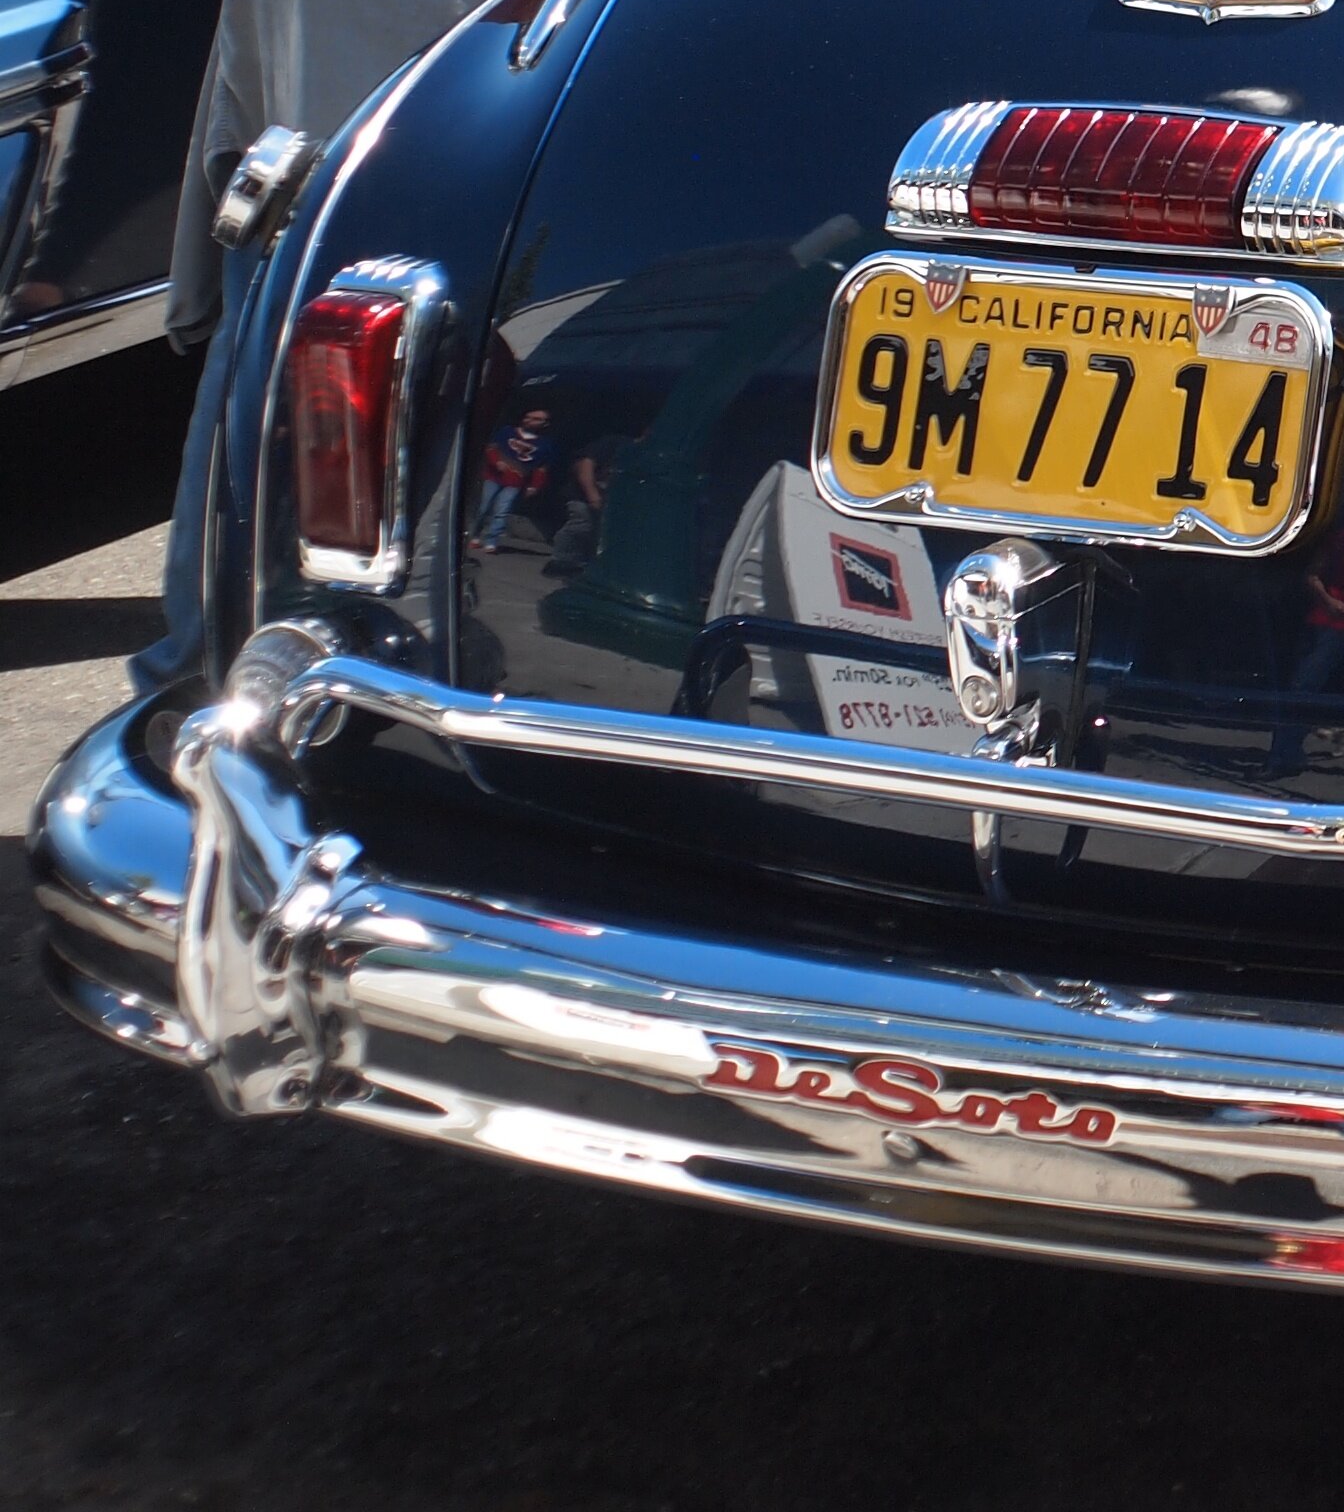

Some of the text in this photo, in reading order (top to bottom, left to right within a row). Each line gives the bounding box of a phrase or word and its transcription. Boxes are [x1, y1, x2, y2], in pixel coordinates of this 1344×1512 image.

[879, 287, 1299, 354] 19 CALIFORNIA 48
[704, 1043, 1117, 1144] DeSoto
